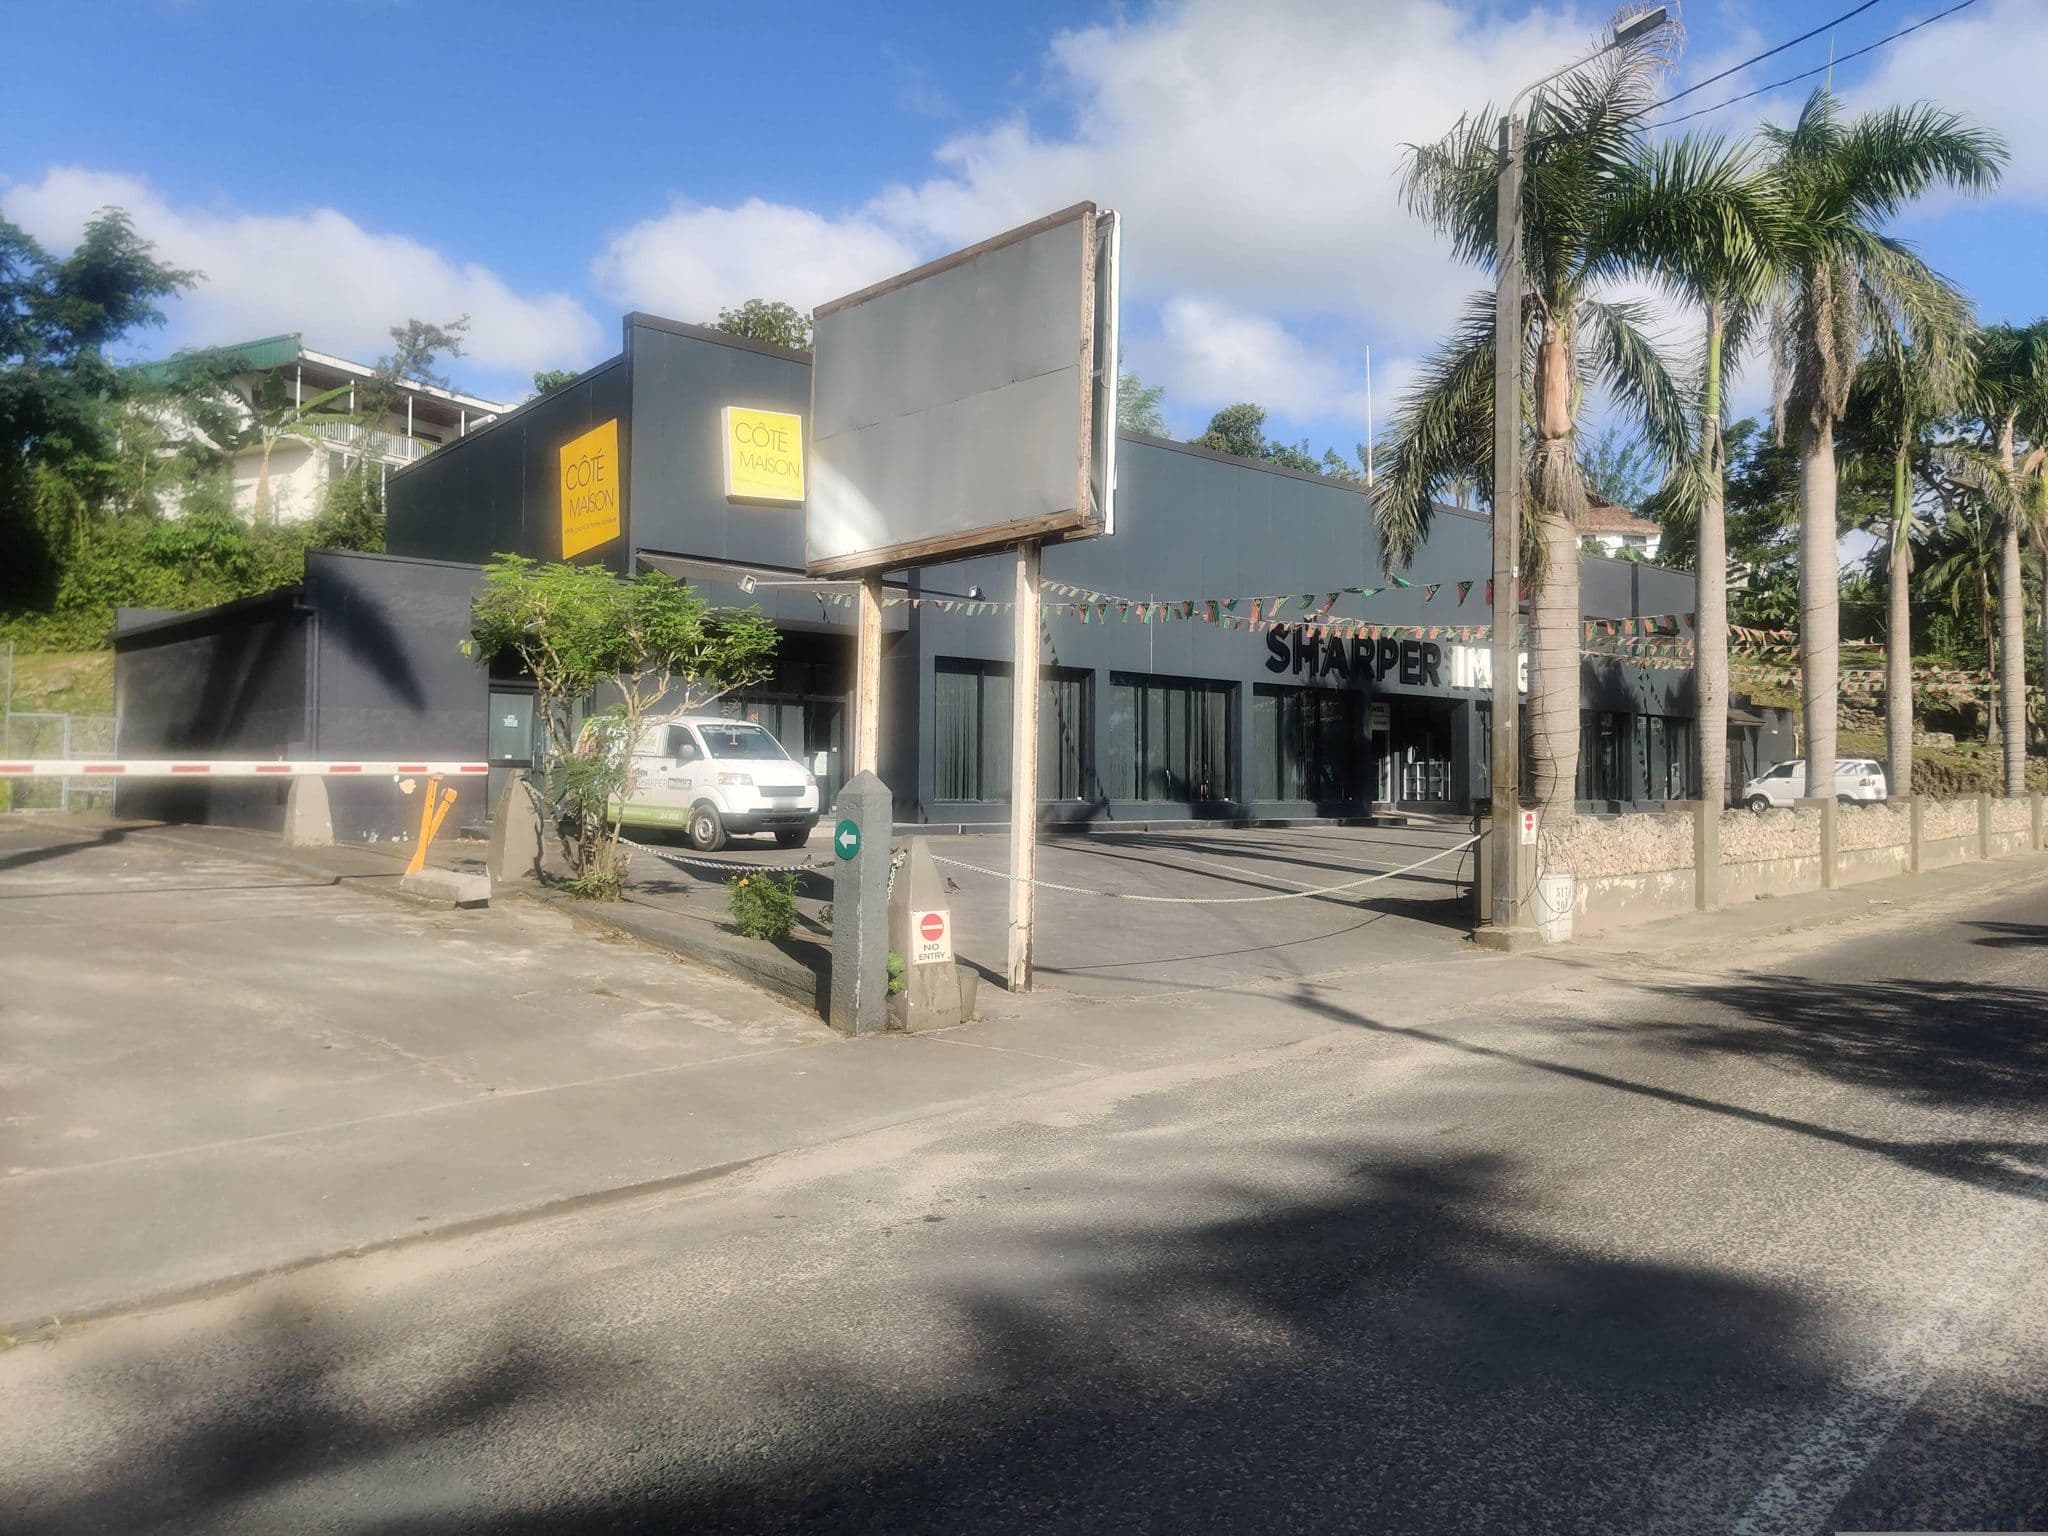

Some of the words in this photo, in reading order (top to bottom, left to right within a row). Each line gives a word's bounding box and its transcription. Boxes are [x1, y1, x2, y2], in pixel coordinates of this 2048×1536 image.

[735, 422, 788, 453] CÔTÉ
[566, 448, 604, 490] CÔTÉ
[740, 451, 799, 478] MAISON
[569, 488, 614, 519] MAISON
[1265, 623, 1442, 687] SHARPER
[1451, 645, 1529, 693] IMG
[918, 951, 945, 960] ENTRY
